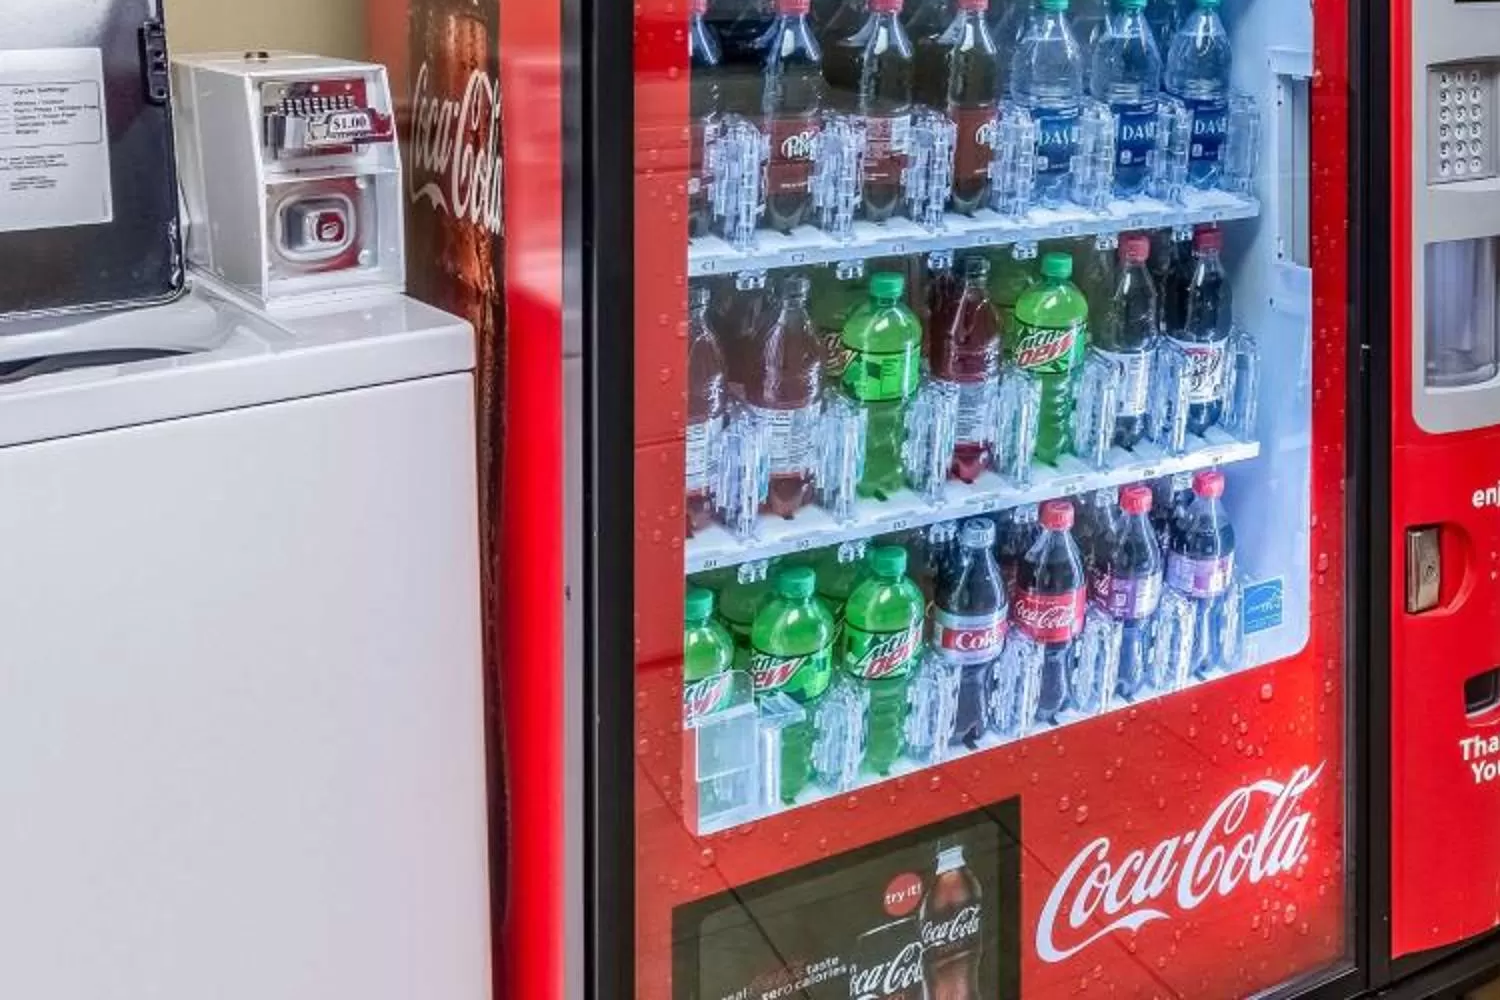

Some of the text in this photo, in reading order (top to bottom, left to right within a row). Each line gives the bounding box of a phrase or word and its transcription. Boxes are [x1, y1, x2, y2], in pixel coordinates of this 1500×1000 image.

[333, 116, 367, 129] $1.00
[1035, 759, 1327, 962] Coca-Cola
[885, 883, 921, 904] try it!
[806, 955, 839, 975] taste
[762, 963, 847, 1000] zero calories
